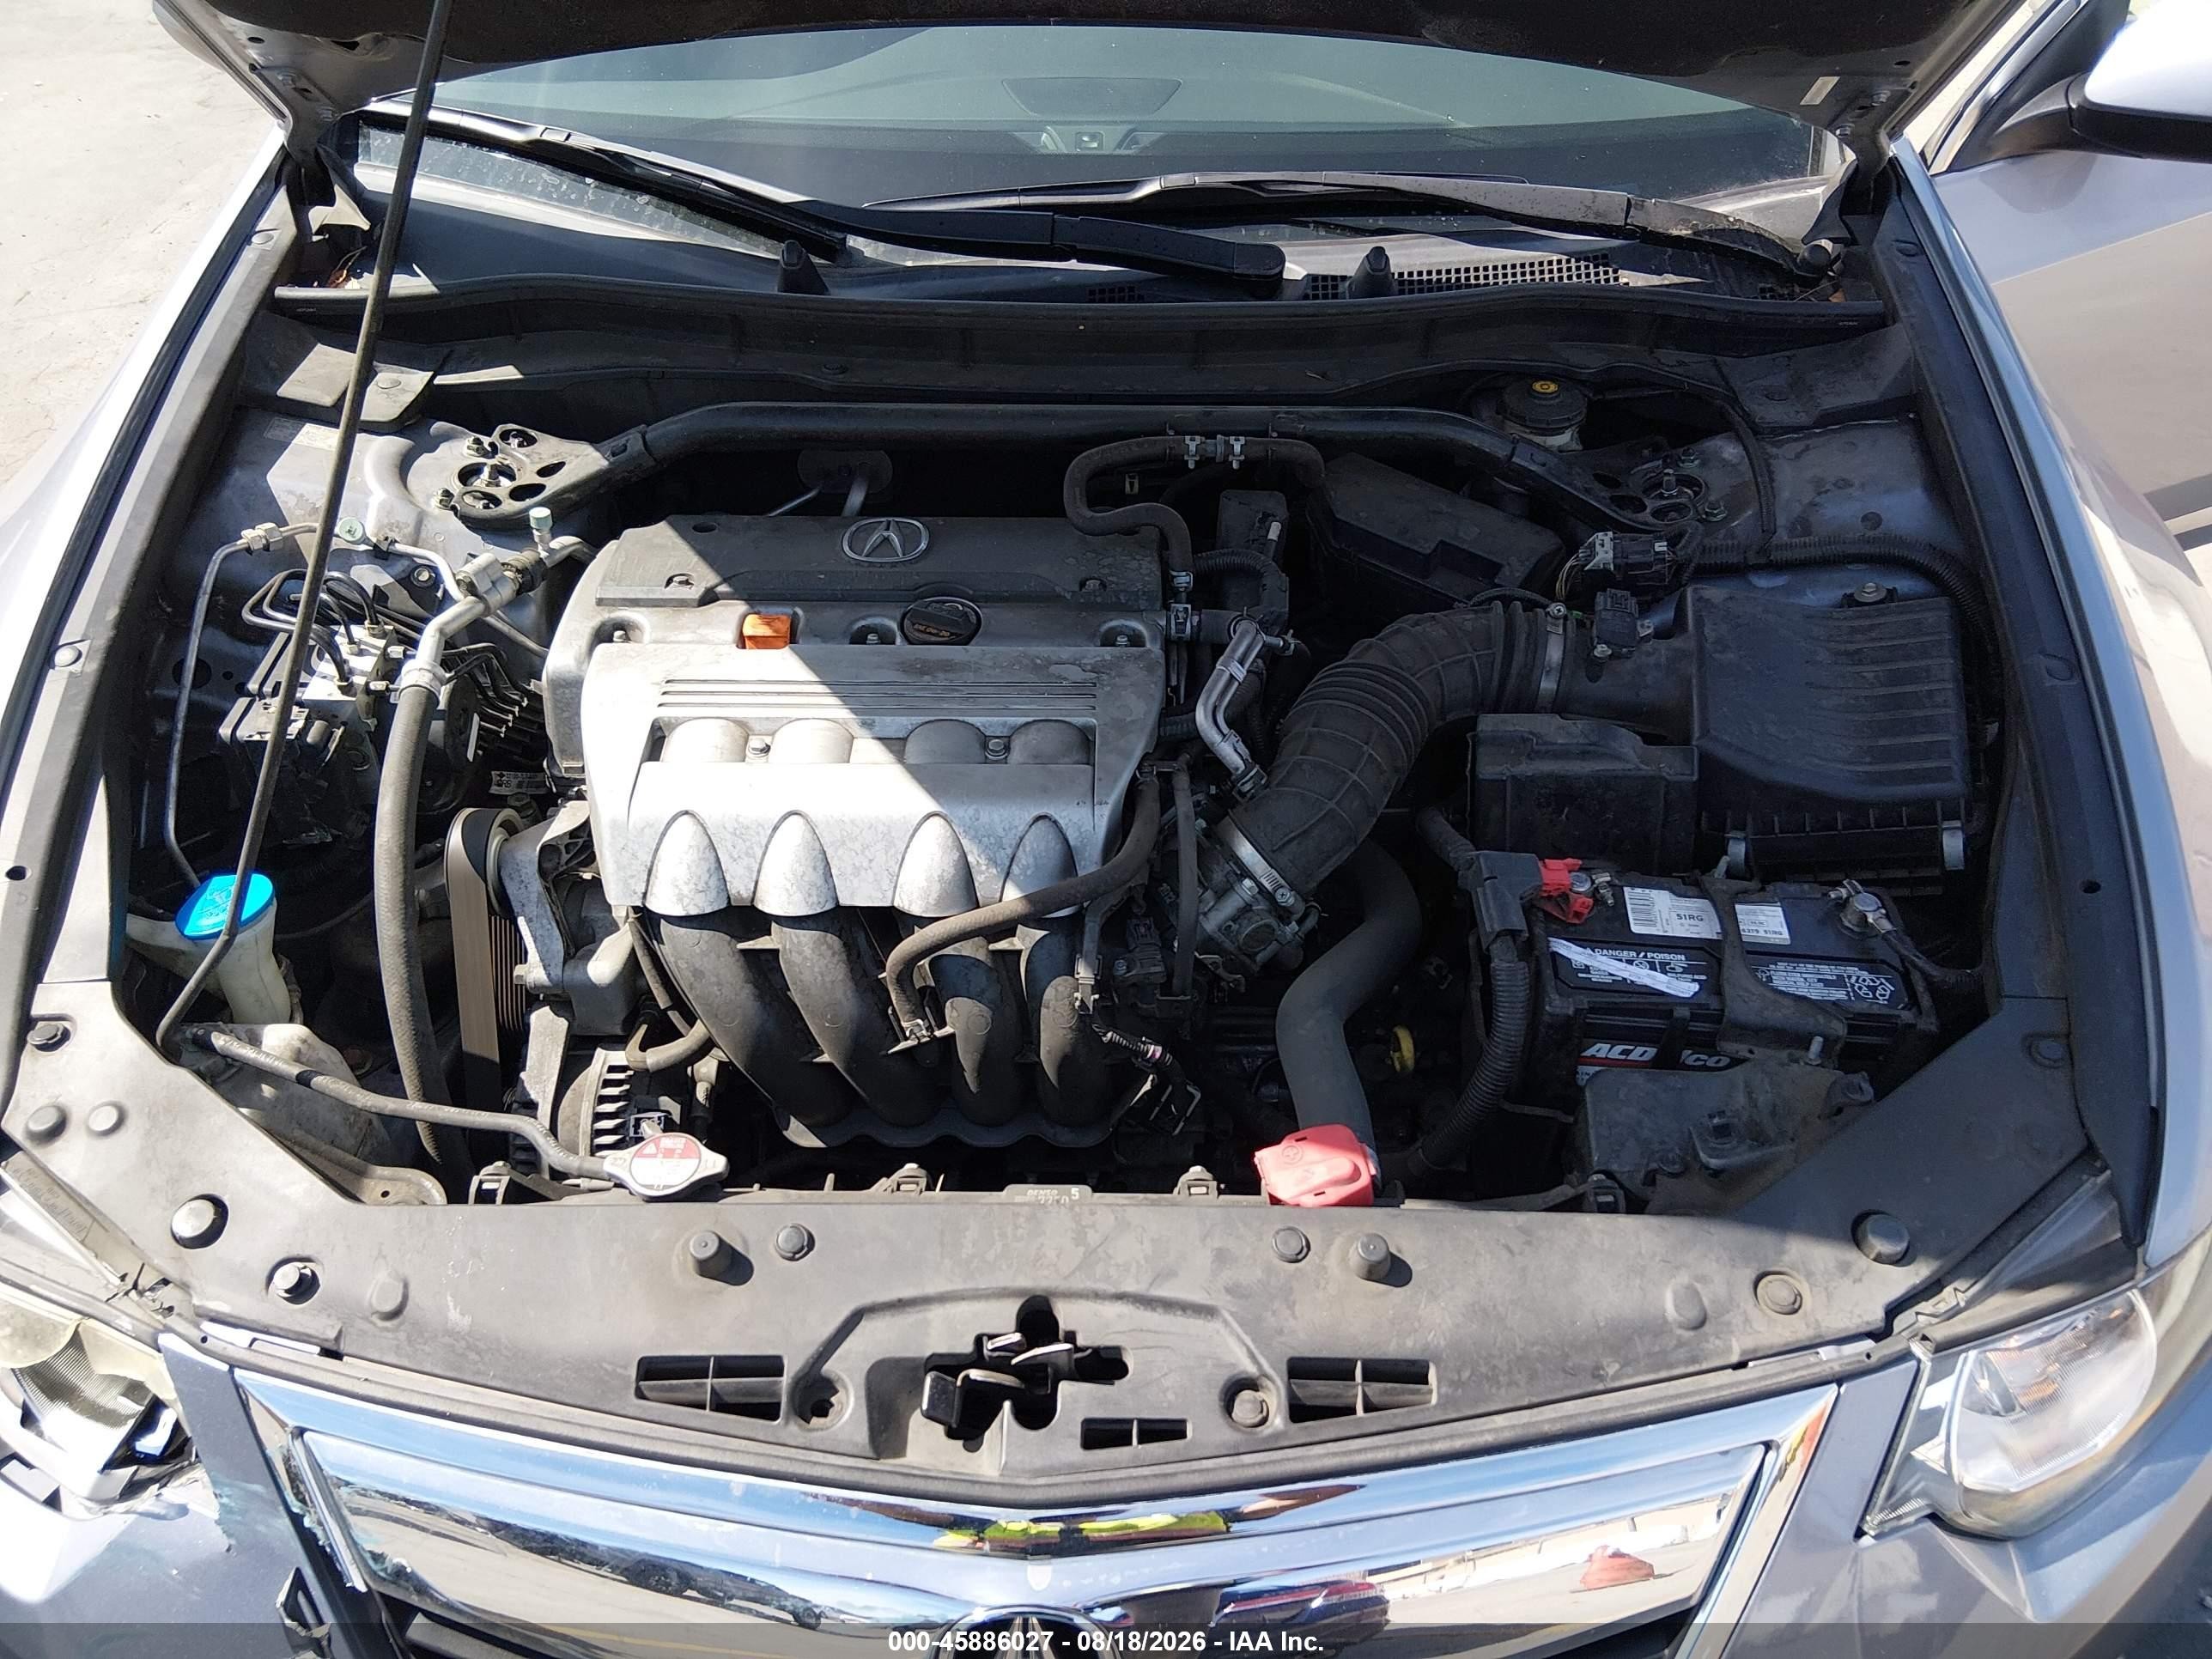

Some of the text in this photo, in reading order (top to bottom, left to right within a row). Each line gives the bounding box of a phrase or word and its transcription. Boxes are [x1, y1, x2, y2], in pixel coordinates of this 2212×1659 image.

[1594, 948, 1637, 958] DANGER
[1647, 951, 1686, 961] POISON
[1071, 1187, 1079, 1200] 5
